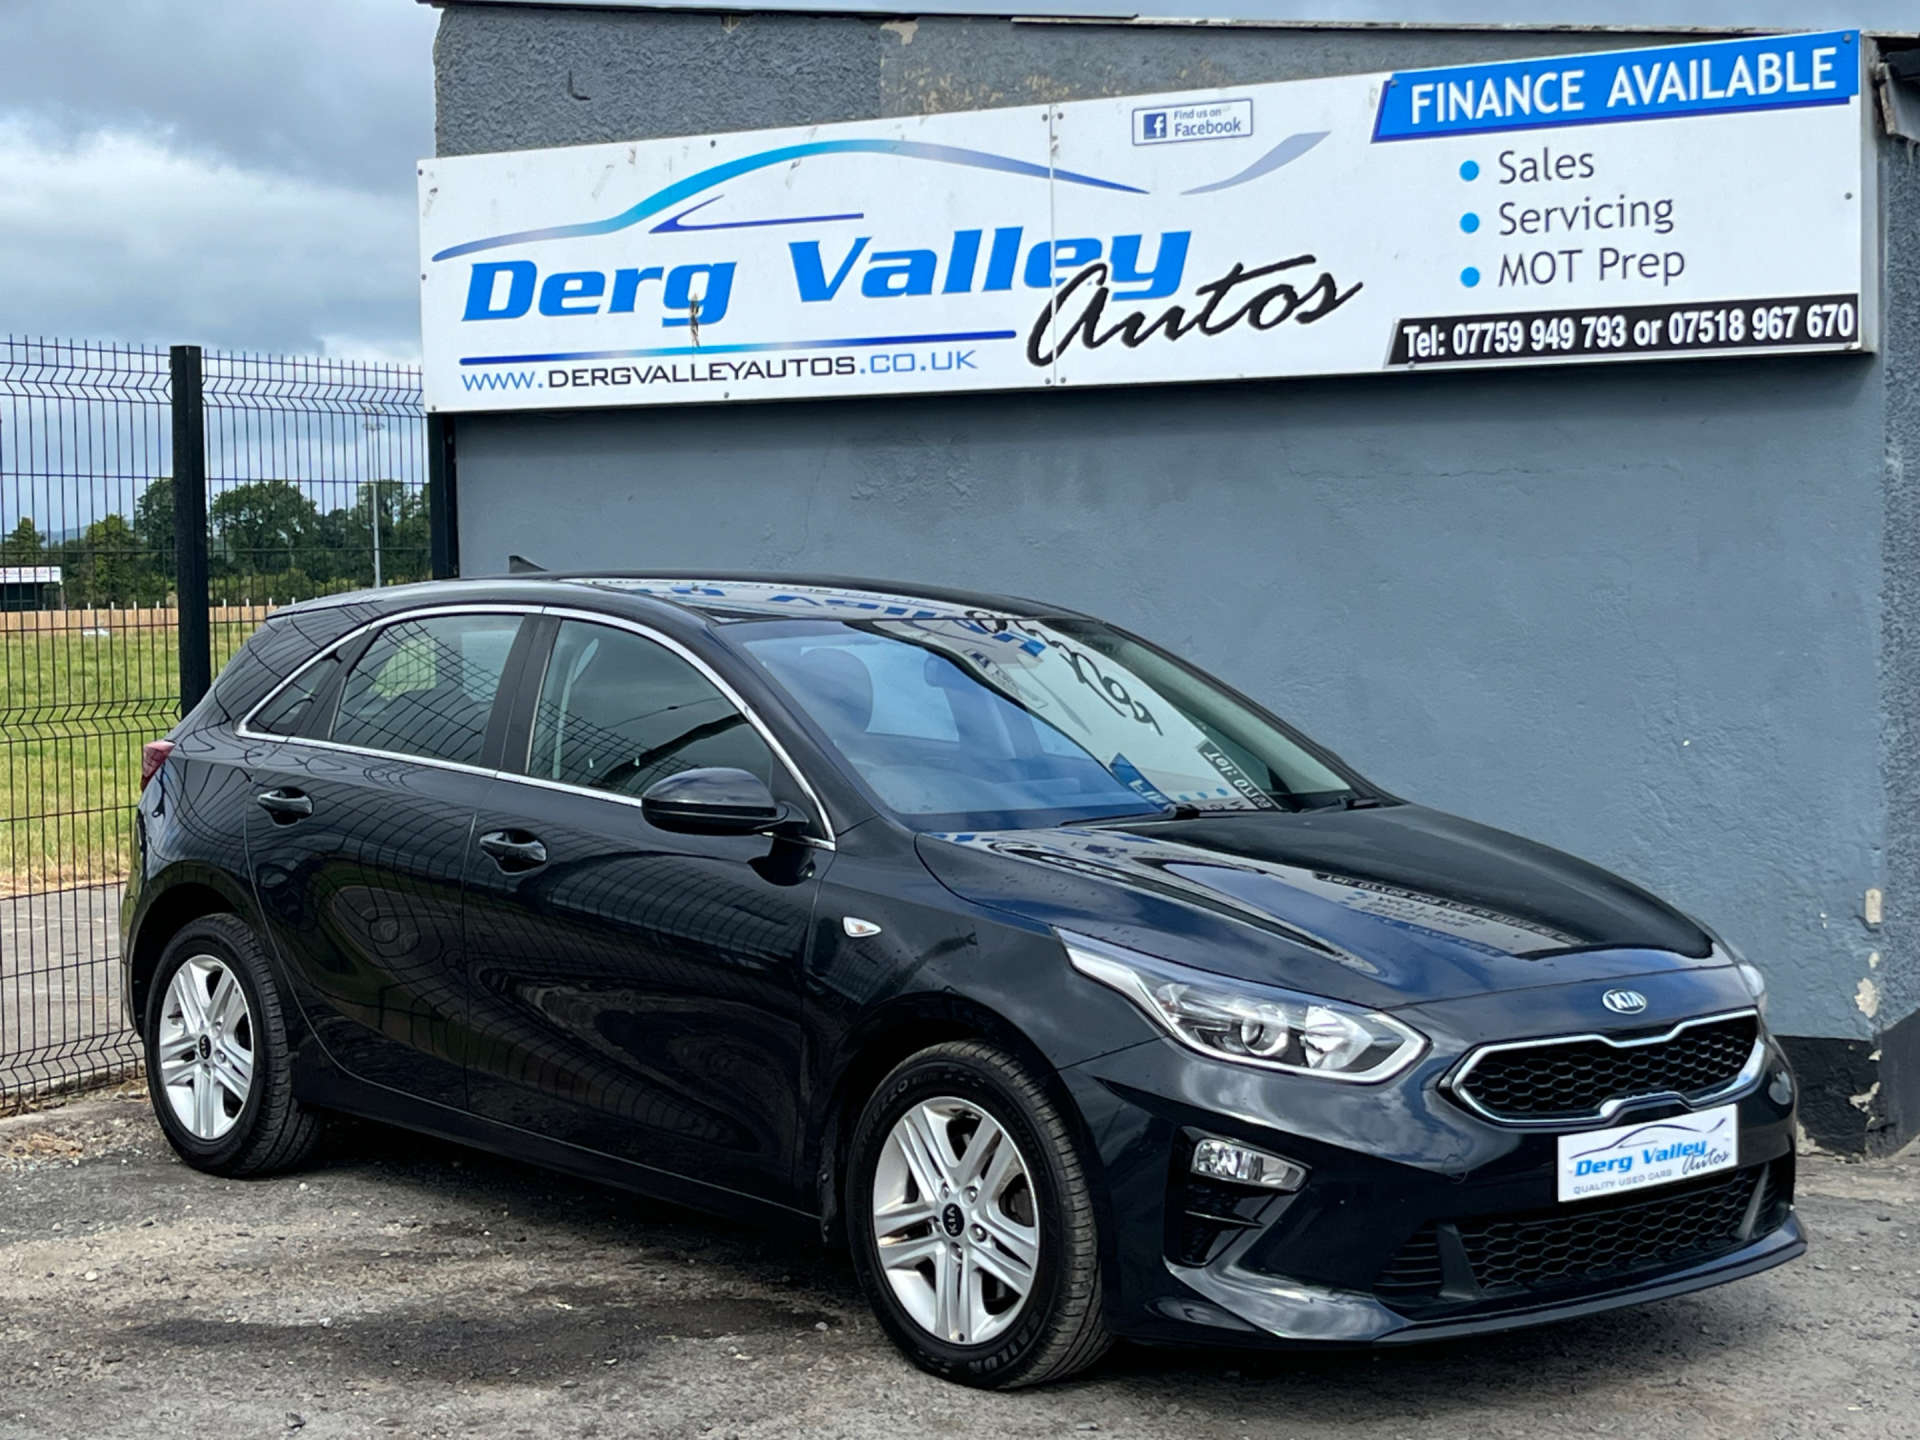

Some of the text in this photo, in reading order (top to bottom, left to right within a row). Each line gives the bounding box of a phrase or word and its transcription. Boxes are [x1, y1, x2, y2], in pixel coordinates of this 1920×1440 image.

[1411, 47, 1837, 124] FINANCE AVAILABLE
[1174, 108, 1221, 120] Find us on
[1175, 117, 1241, 137] Facebook
[1499, 147, 1594, 184] Sales
[1499, 194, 1674, 235] Servicing
[462, 226, 1192, 328] Derg Valley
[1498, 247, 1685, 287] MOT Prep
[1027, 254, 1364, 367] Autos
[1403, 302, 1853, 358] Tel: 07759 949 793 or 07518 967 670
[1575, 1140, 1707, 1177] Derg Valley
[1682, 1149, 1730, 1175] Autos
[1574, 1169, 1672, 1194] QUALITY USED CARS
